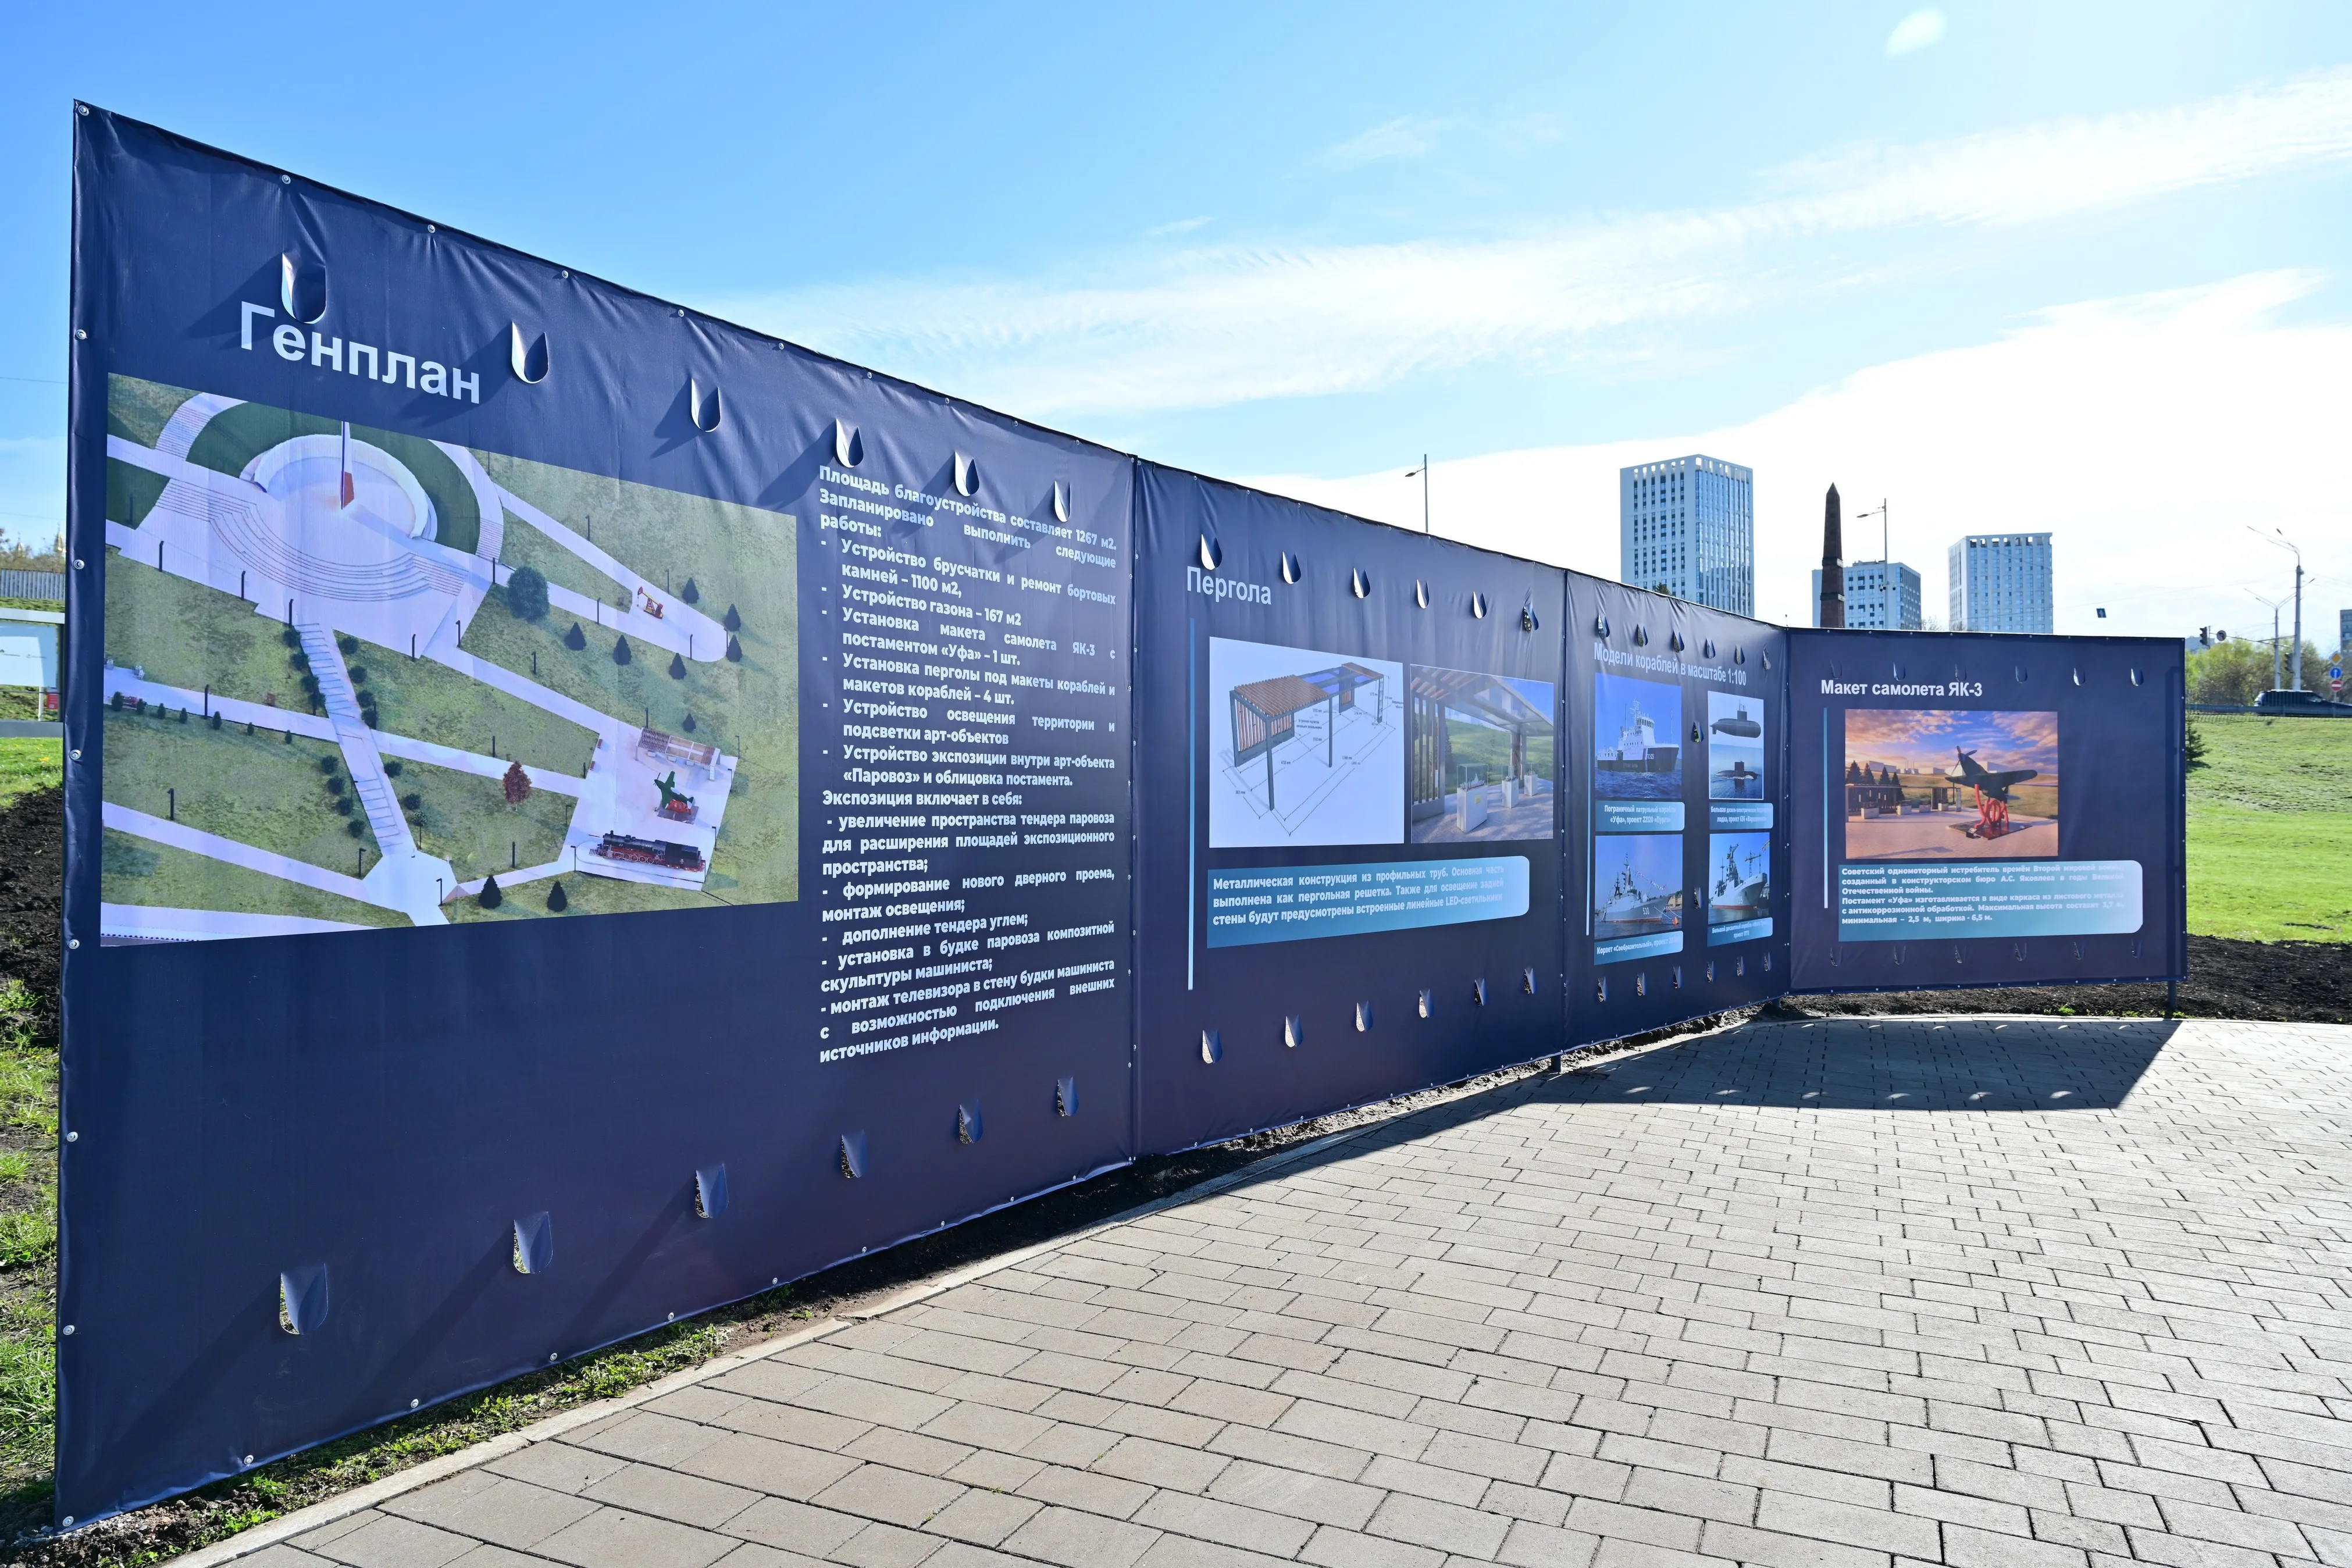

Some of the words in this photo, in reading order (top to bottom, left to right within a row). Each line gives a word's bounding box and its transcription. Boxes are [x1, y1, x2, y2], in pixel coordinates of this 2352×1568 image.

[241, 301, 479, 404] Генплан
[819, 465, 890, 496] Площадь
[895, 484, 1006, 524] благоустройства
[1010, 516, 1072, 539] составляет
[1076, 529, 1097, 546] 1267
[1102, 538, 1117, 550] м2.
[819, 489, 934, 527] Запланировано
[964, 525, 1031, 549] выполнить
[1056, 546, 1116, 568] следующие
[820, 514, 882, 537] работы:
[842, 539, 926, 569] Устройство
[933, 558, 1000, 583] брусчатки
[1021, 576, 1061, 595] ремонт
[1067, 585, 1116, 605] бортовых
[842, 564, 897, 584] камней
[911, 574, 938, 590] 1100
[942, 581, 961, 598] м2,
[1188, 566, 1271, 604] Пергола
[842, 585, 926, 611] Устройство
[930, 601, 972, 619] газона
[985, 608, 1003, 623] 167
[1007, 613, 1021, 626] м2
[842, 607, 919, 632] Установка
[940, 623, 985, 640] макета
[1004, 633, 1056, 651] самолета
[1072, 643, 1095, 656] ЯК-3
[843, 633, 938, 656] постаментом
[942, 644, 981, 661] «Уфа»
[1001, 653, 1020, 665] шт.
[1594, 642, 1633, 667] Модели
[1635, 655, 1677, 675] кораблей
[1688, 664, 1726, 682] масштабе
[1728, 668, 1746, 686] 1:100
[843, 653, 920, 675] Установка
[925, 665, 980, 682] перголы
[985, 672, 1007, 686] под
[1011, 673, 1053, 689] макеты
[1057, 679, 1106, 694] кораблей
[1821, 679, 1867, 695] Макет
[1872, 682, 1944, 696] самолета
[1948, 682, 1982, 697] ЯК-3
[843, 678, 904, 695] макетов
[908, 683, 971, 701] кораблей
[995, 692, 1014, 705] шт.
[843, 699, 927, 719] Устройство
[947, 708, 1015, 725] освещения
[1032, 716, 1095, 732] территории
[843, 725, 921, 740] подсветки
[924, 730, 1008, 744] арт-объектов
[843, 745, 927, 764] Устройство
[932, 750, 1006, 765] экспозиции
[1011, 755, 1050, 768] внутри
[1054, 756, 1114, 769] арт-объекта
[843, 768, 920, 786] «Паровоз»
[936, 771, 1003, 786] облицовка
[1007, 774, 1073, 786] постамента.
[823, 790, 912, 805] Экспозиция
[916, 794, 979, 806] включает
[992, 793, 1022, 806] себя:
[1605, 805, 1634, 813] Пограничный
[839, 815, 926, 832] увеличение
[932, 813, 1016, 830] пространства
[1021, 814, 1065, 826] тендера
[1070, 813, 1114, 824] паровоза
[1610, 816, 1626, 824] «Уфа»,
[823, 840, 851, 854] для
[860, 836, 949, 852] расширения
[956, 831, 1018, 848] площадей
[1024, 832, 1114, 845] экспозиционного
[823, 858, 928, 878] пространства;
[1213, 878, 1293, 890] Металлическая
[1299, 873, 1357, 886] конструкция
[1362, 873, 1371, 882] из
[1376, 869, 1426, 884] профильных
[1430, 868, 1448, 879] труб.
[1452, 865, 1482, 876] Основная
[1887, 867, 1948, 875] одномоторный
[2002, 865, 2030, 874] времён
[1902, 877, 1971, 885] конструкторском
[843, 879, 950, 900] формирование
[963, 875, 1004, 889] нового
[1015, 872, 1066, 886] дверного
[1076, 868, 1114, 882] проема,
[1213, 895, 1272, 908] выполнена
[1277, 893, 1293, 904] как
[1298, 889, 1350, 904] пергольная
[1355, 888, 1392, 900] решетка.
[1396, 883, 1420, 896] Также
[1424, 883, 1437, 895] для
[1441, 881, 1477, 892] освещение
[1480, 878, 1504, 889] задней
[823, 906, 882, 922] монтаж
[885, 900, 964, 917] освещения;
[1213, 913, 1246, 925] стены
[1248, 910, 1278, 925] будут
[1281, 905, 1354, 922] предусмотрены
[1356, 901, 1405, 915] встроенные
[1406, 897, 1444, 910] линейные
[1446, 893, 1502, 907] LED-светильники
[1848, 906, 1925, 914] антикоррозионной
[842, 923, 931, 945] дополнение
[934, 918, 987, 934] тендера
[990, 914, 1028, 930] углем;
[838, 946, 914, 970] установка
[940, 939, 978, 954] будке
[988, 932, 1040, 949] паровоза
[1047, 921, 1114, 942] композитной
[1597, 946, 1613, 955] Корвет
[821, 969, 912, 993] скульптуры
[915, 958, 992, 979] машиниста;
[831, 996, 889, 1014] монтаж
[893, 983, 970, 1005] телевизора
[983, 976, 1017, 991] стену
[1020, 970, 1054, 986] будки
[1057, 960, 1114, 978] машиниста
[851, 1006, 957, 1034] возможностью
[975, 988, 1055, 1013] подключения
[1070, 978, 1114, 996] внешних
[820, 1036, 908, 1063] источников
[912, 1018, 999, 1045] информации.
